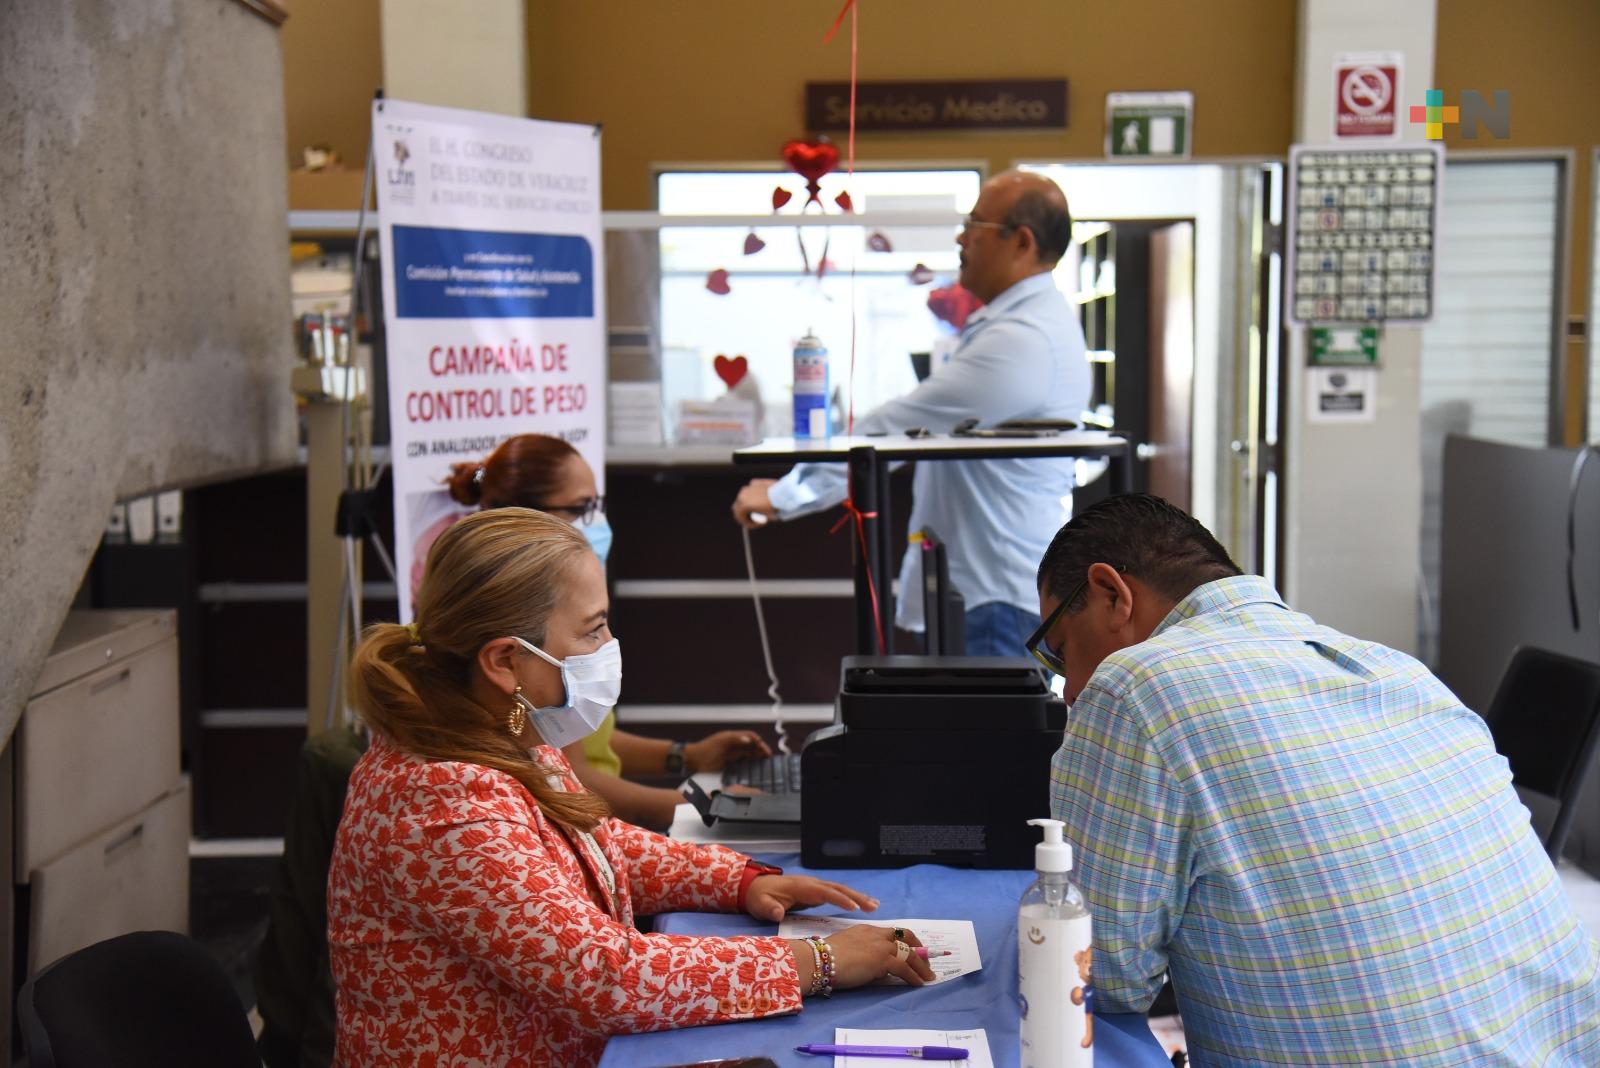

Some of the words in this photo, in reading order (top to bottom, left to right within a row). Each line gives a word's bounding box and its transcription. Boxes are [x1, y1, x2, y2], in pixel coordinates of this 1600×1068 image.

[825, 95, 934, 123] Servicio
[429, 338, 535, 377] CAMPAÑA
[541, 344, 568, 372] DE
[406, 388, 504, 422] CONTROL
[510, 386, 536, 416] DE
[543, 384, 588, 414] PESO
[406, 441, 428, 458] CON
[431, 435, 496, 457] ANALIZADOR
